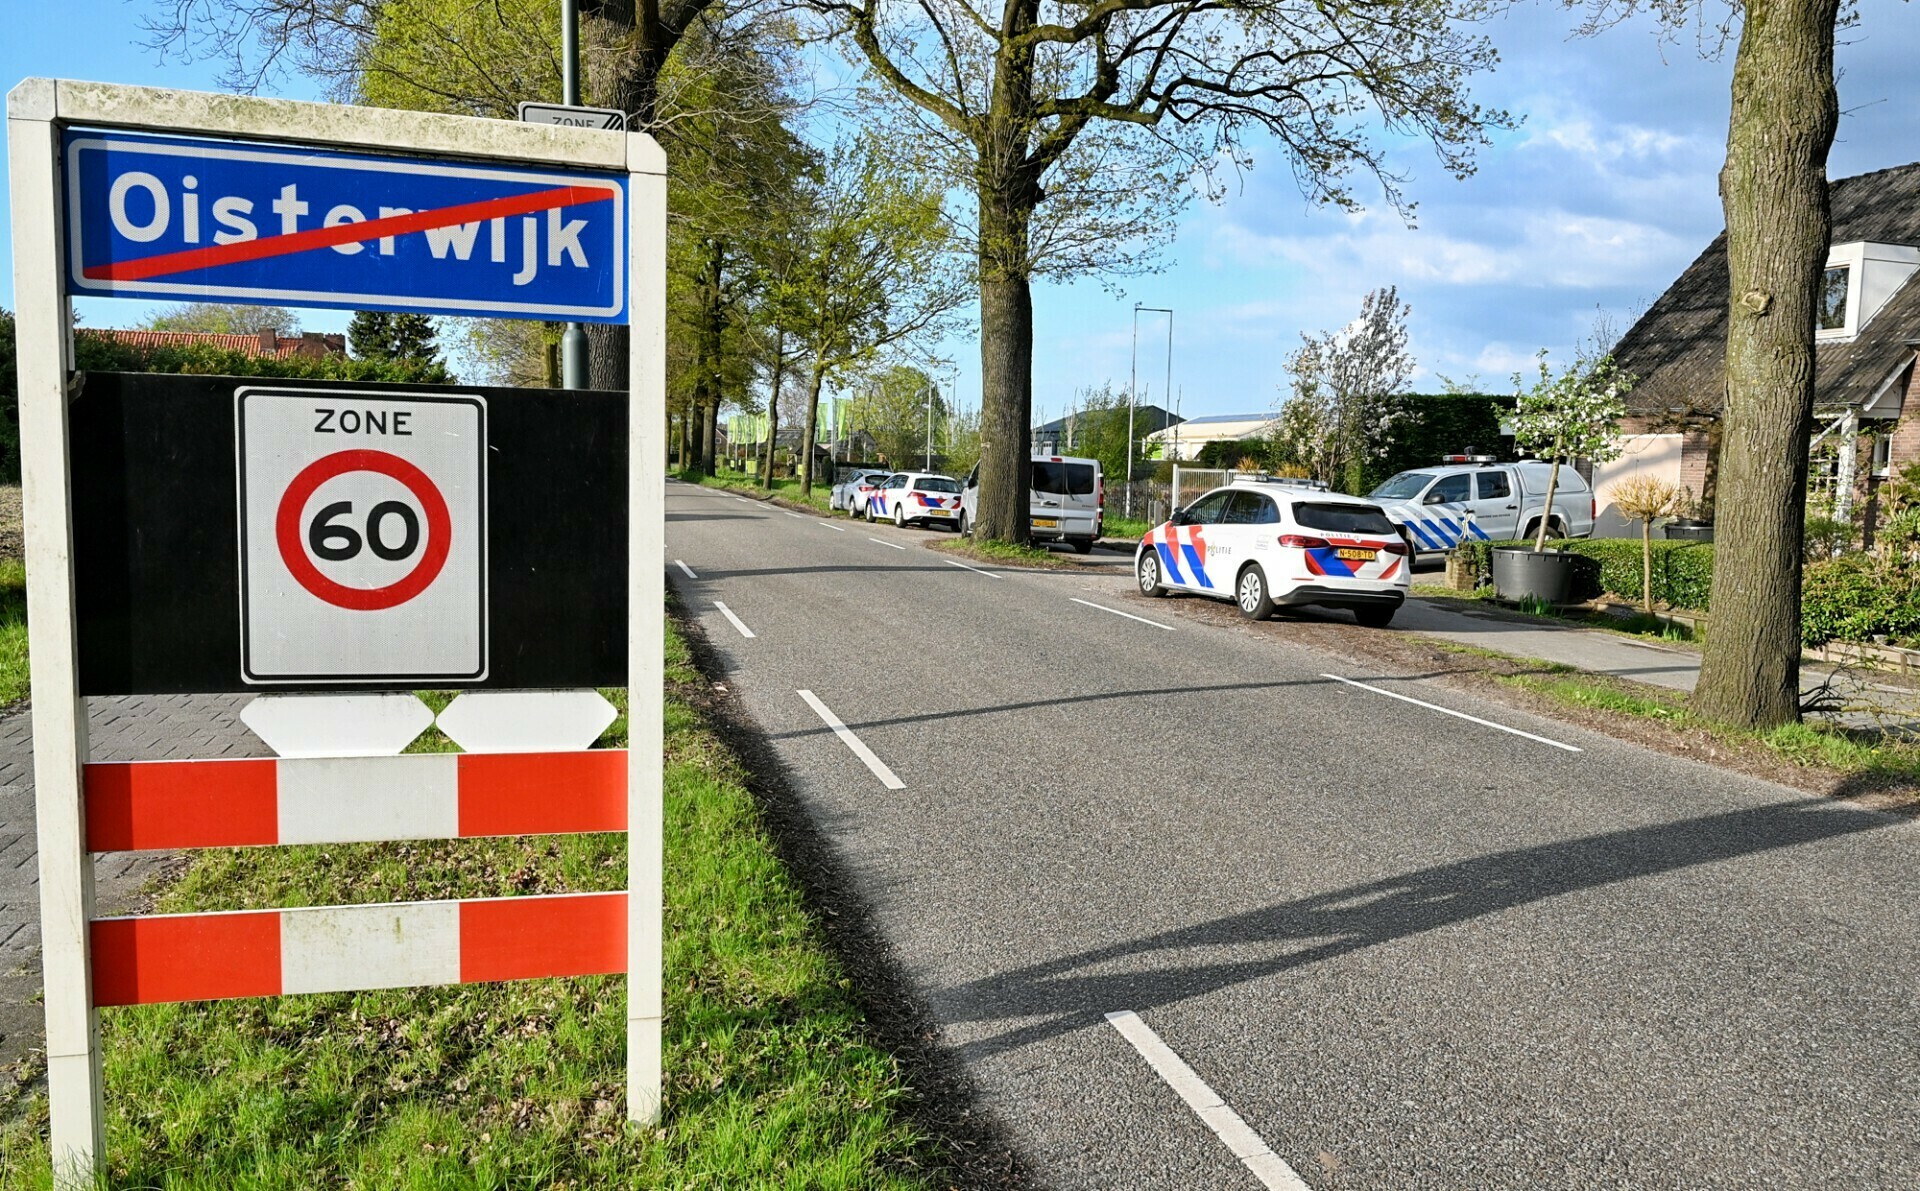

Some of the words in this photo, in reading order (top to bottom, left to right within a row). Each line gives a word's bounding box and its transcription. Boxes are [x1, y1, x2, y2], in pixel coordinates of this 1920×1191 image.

[552, 116, 595, 128] ZONE
[109, 171, 589, 286] Oisterwijk
[314, 408, 413, 436] ZONE
[308, 500, 420, 562] 60
